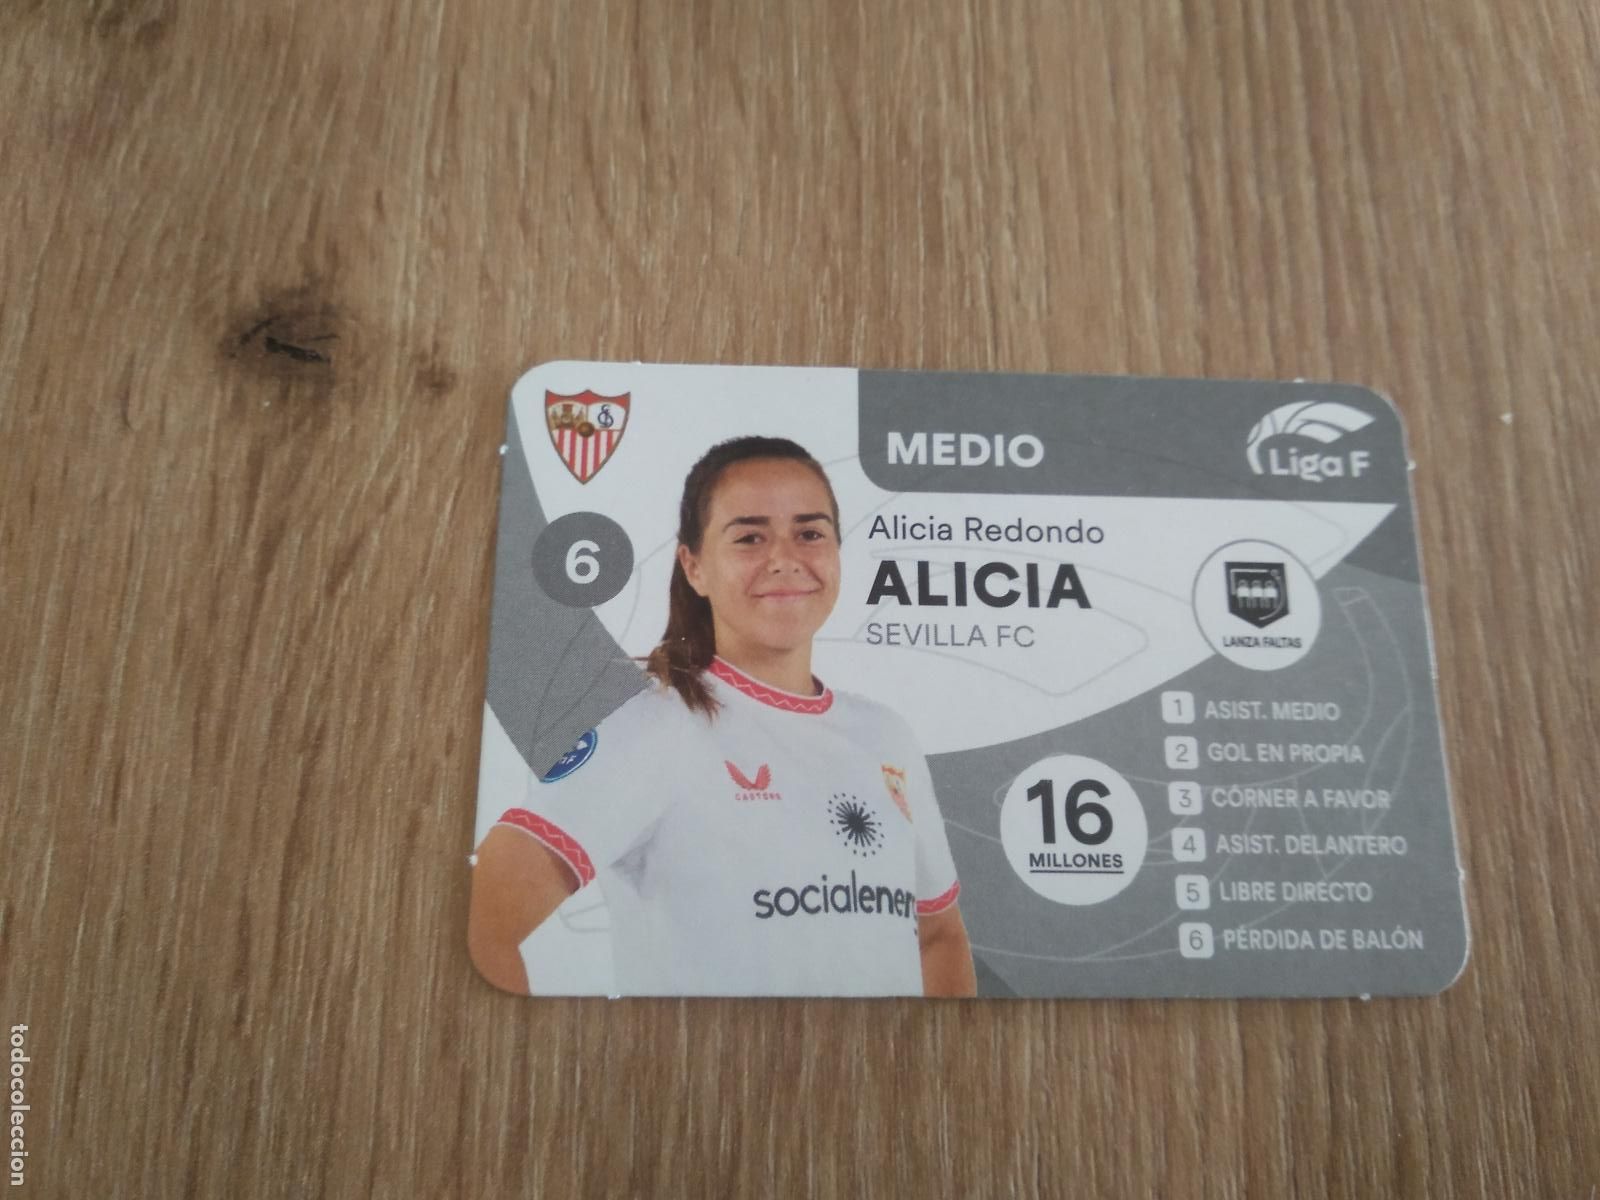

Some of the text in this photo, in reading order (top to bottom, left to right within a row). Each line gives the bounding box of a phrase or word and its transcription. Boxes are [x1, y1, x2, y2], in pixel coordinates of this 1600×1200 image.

[887, 431, 1045, 469] MEDIO
[1269, 447, 1370, 482] Liga F
[868, 515, 1105, 545] Alicia Redondo
[565, 539, 601, 585] 6
[866, 560, 1092, 609] ALICIA
[866, 622, 1035, 649] SEVILLA FC
[1172, 698, 1341, 721] 1 ASIST. MEDIO
[1175, 743, 1366, 765] 2 GOL EN PROPIA
[1025, 778, 1115, 847] 16
[1178, 789, 1192, 809] 3
[1303, 789, 1319, 809] A
[1323, 789, 1392, 809] FAVOR
[1181, 834, 1408, 856] 4 ASIST. DELANTERO
[1028, 852, 1124, 869] MILLONES
[753, 869, 917, 921] socialener
[1185, 881, 1373, 903] 5 LIBRE DIRECTO
[1189, 925, 1424, 951] 6 PÉRDIDA DE BALÓN
